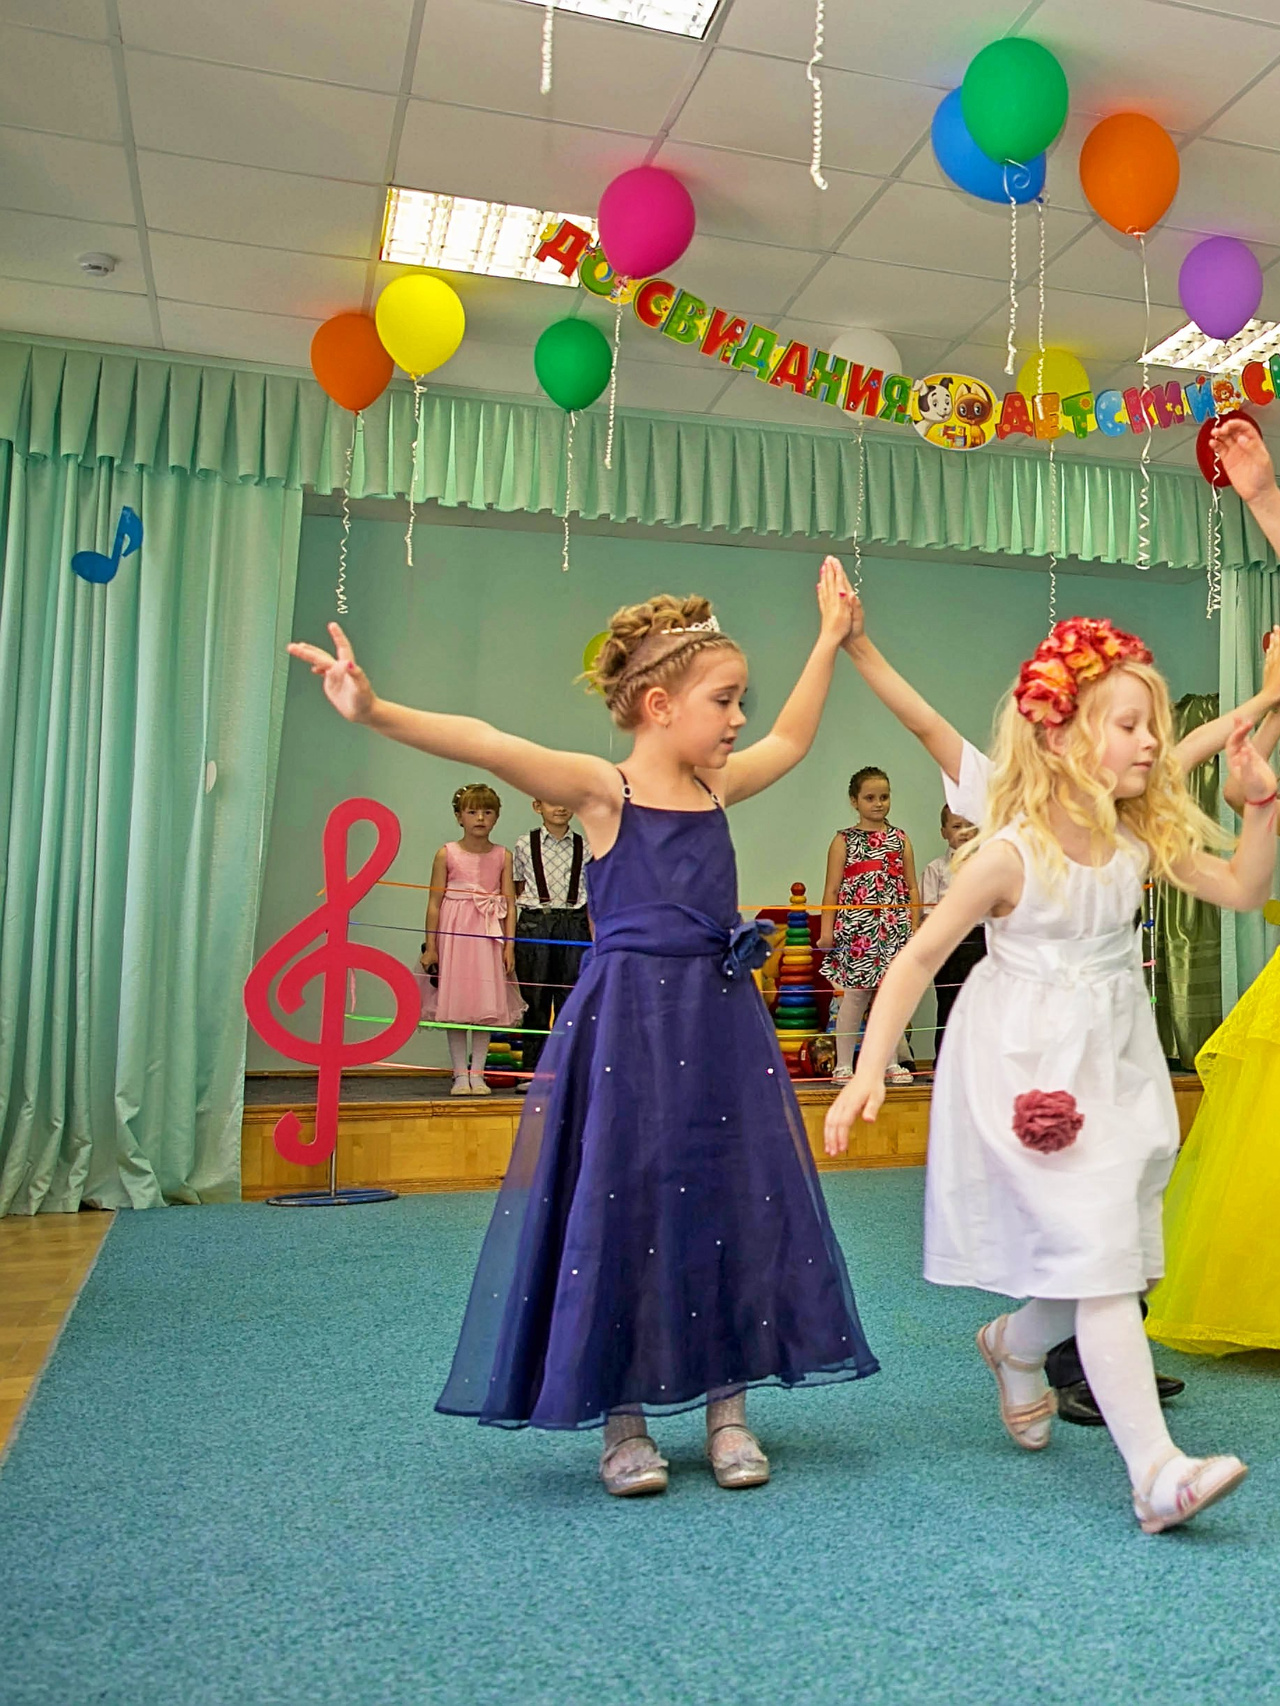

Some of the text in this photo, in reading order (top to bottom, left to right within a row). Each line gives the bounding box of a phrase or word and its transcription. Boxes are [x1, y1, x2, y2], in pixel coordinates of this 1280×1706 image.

[533, 218, 620, 297] ДО
[633, 277, 914, 425] СВИДАНИЯ
[995, 374, 1216, 440] ДЕТСКИЙ
